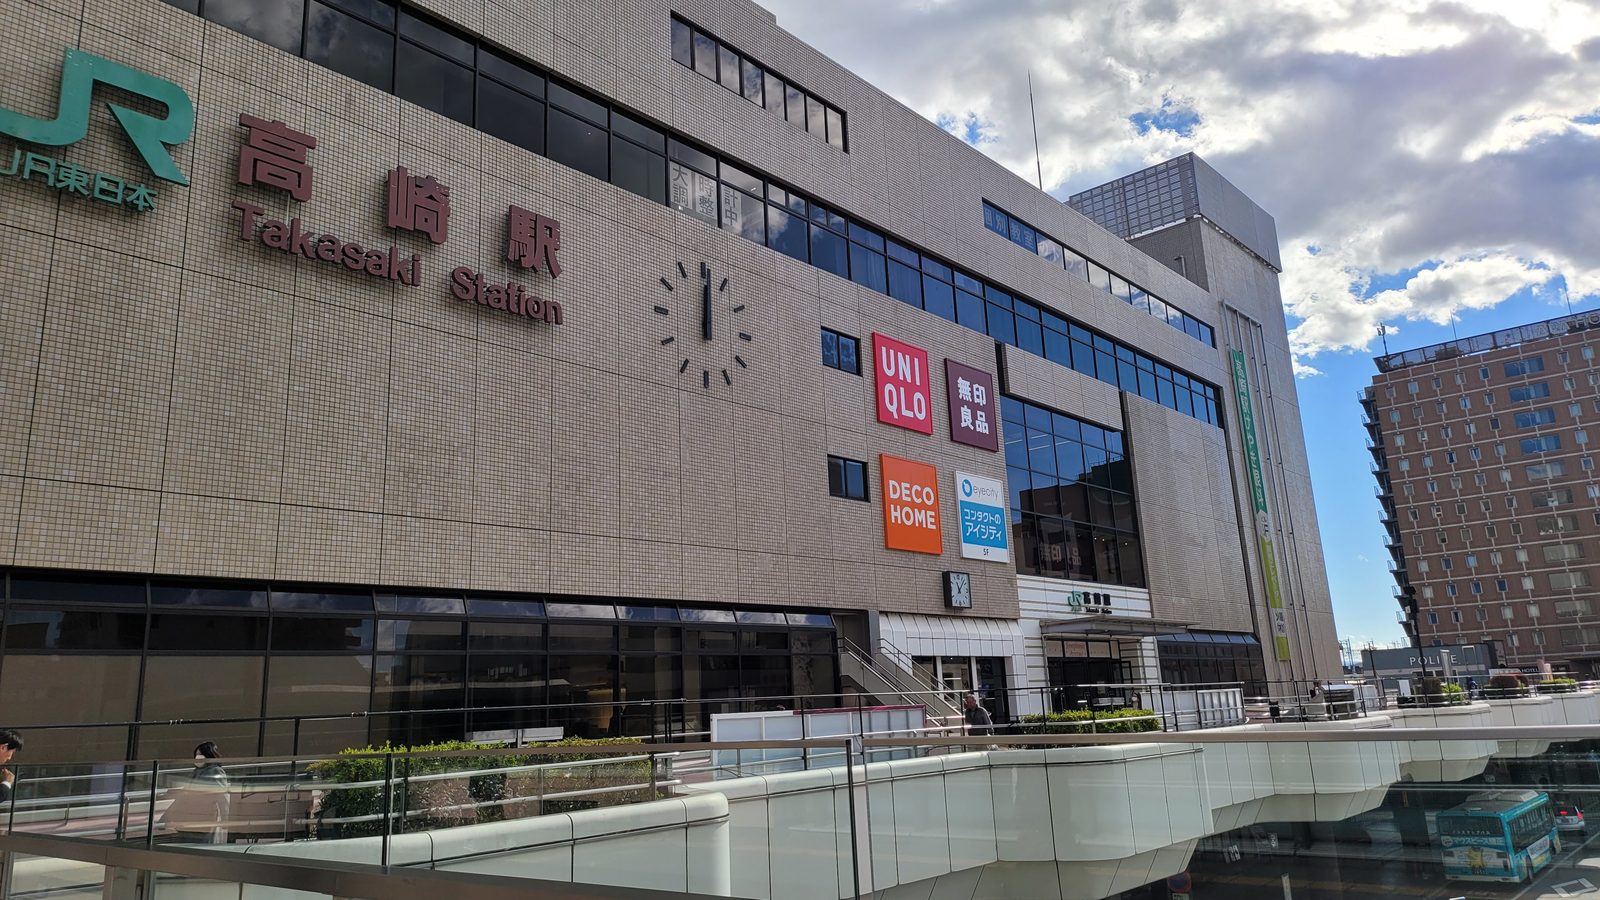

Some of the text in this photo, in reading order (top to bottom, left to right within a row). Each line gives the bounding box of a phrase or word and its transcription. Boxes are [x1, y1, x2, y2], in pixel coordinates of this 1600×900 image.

[0, 47, 195, 187] JR
[0, 147, 158, 213] JR東日本
[238, 112, 563, 280] 高崎駅
[231, 200, 564, 326] Takasaki Station
[881, 346, 921, 386] UNI
[884, 383, 927, 421] QLO
[957, 376, 986, 406] 無印
[960, 405, 990, 435] 良品
[888, 479, 935, 506] DECO
[973, 485, 999, 501] eyecity
[890, 504, 937, 530] HOME
[964, 508, 1002, 525] コンタクトの
[965, 522, 1003, 541] アイシティ
[1409, 654, 1457, 666] POLIE
